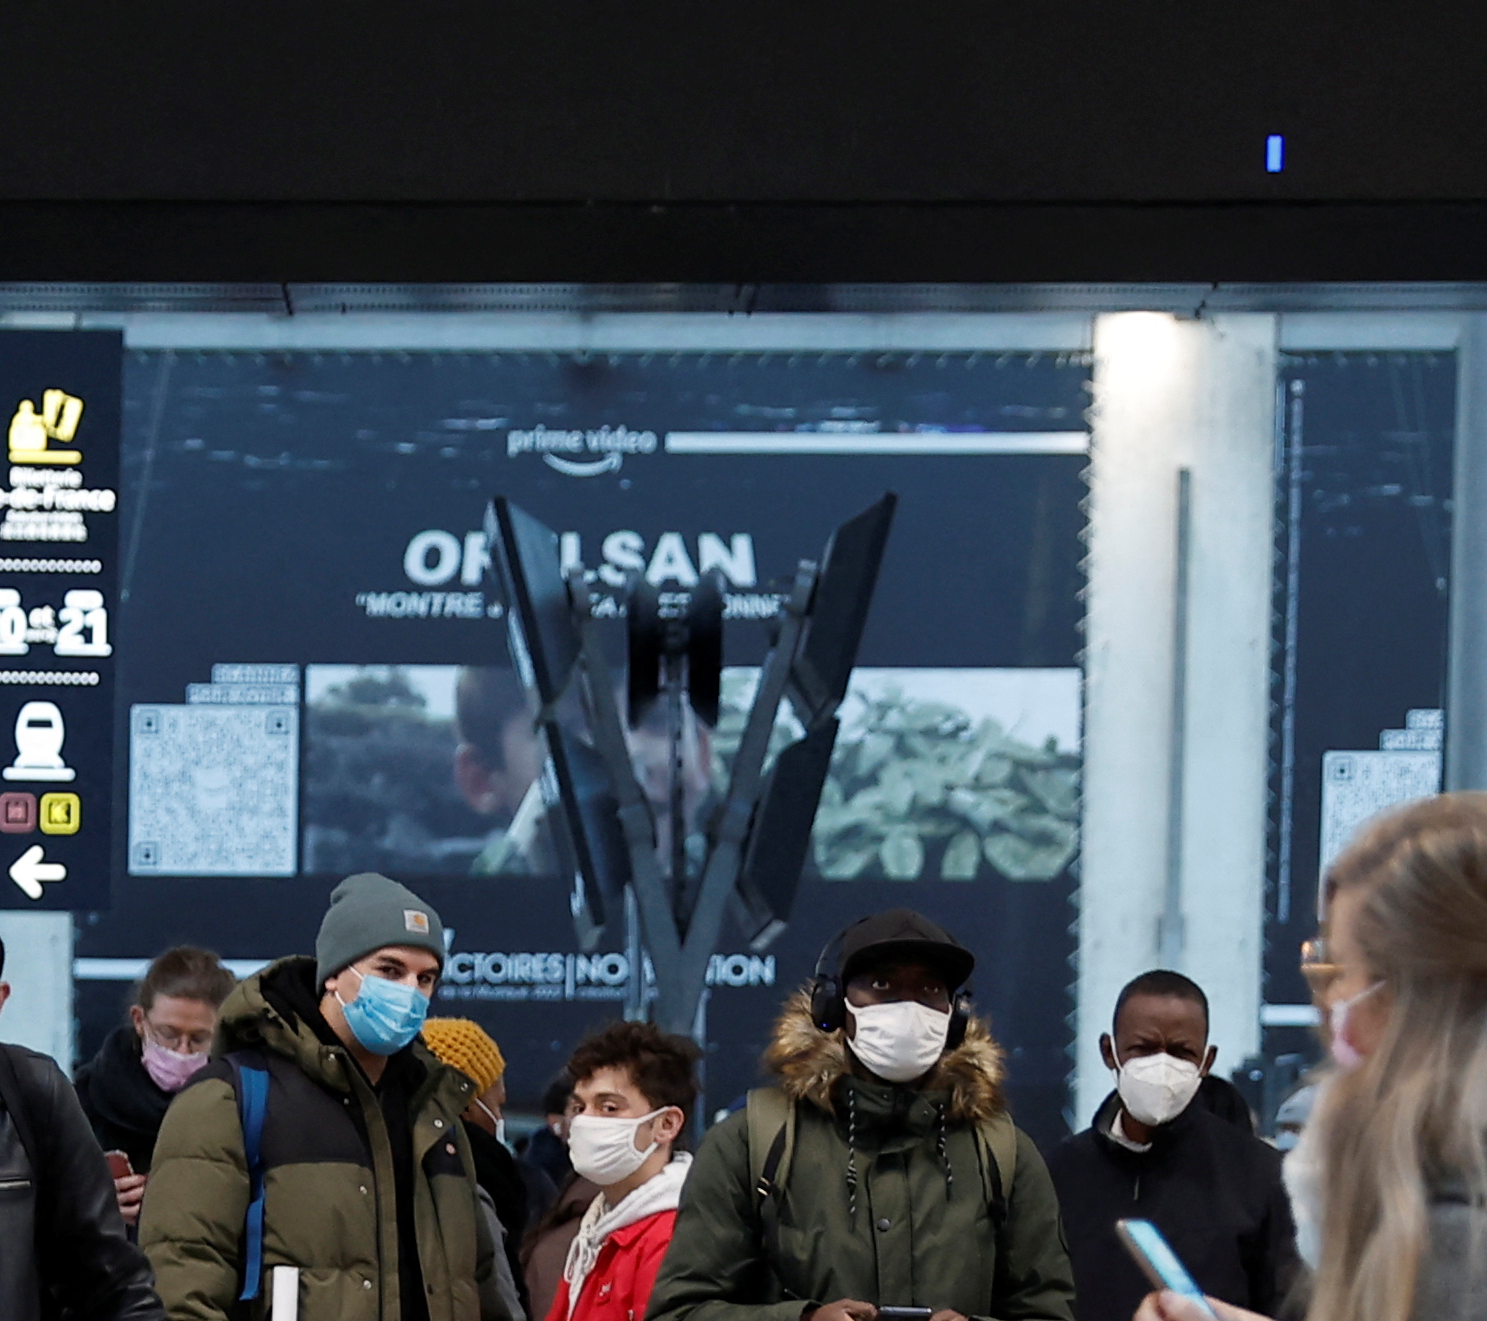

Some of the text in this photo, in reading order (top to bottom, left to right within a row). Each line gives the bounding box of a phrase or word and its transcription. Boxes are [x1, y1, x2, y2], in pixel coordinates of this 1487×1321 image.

[507, 423, 658, 458] prime video
[57, 606, 108, 646] 21
